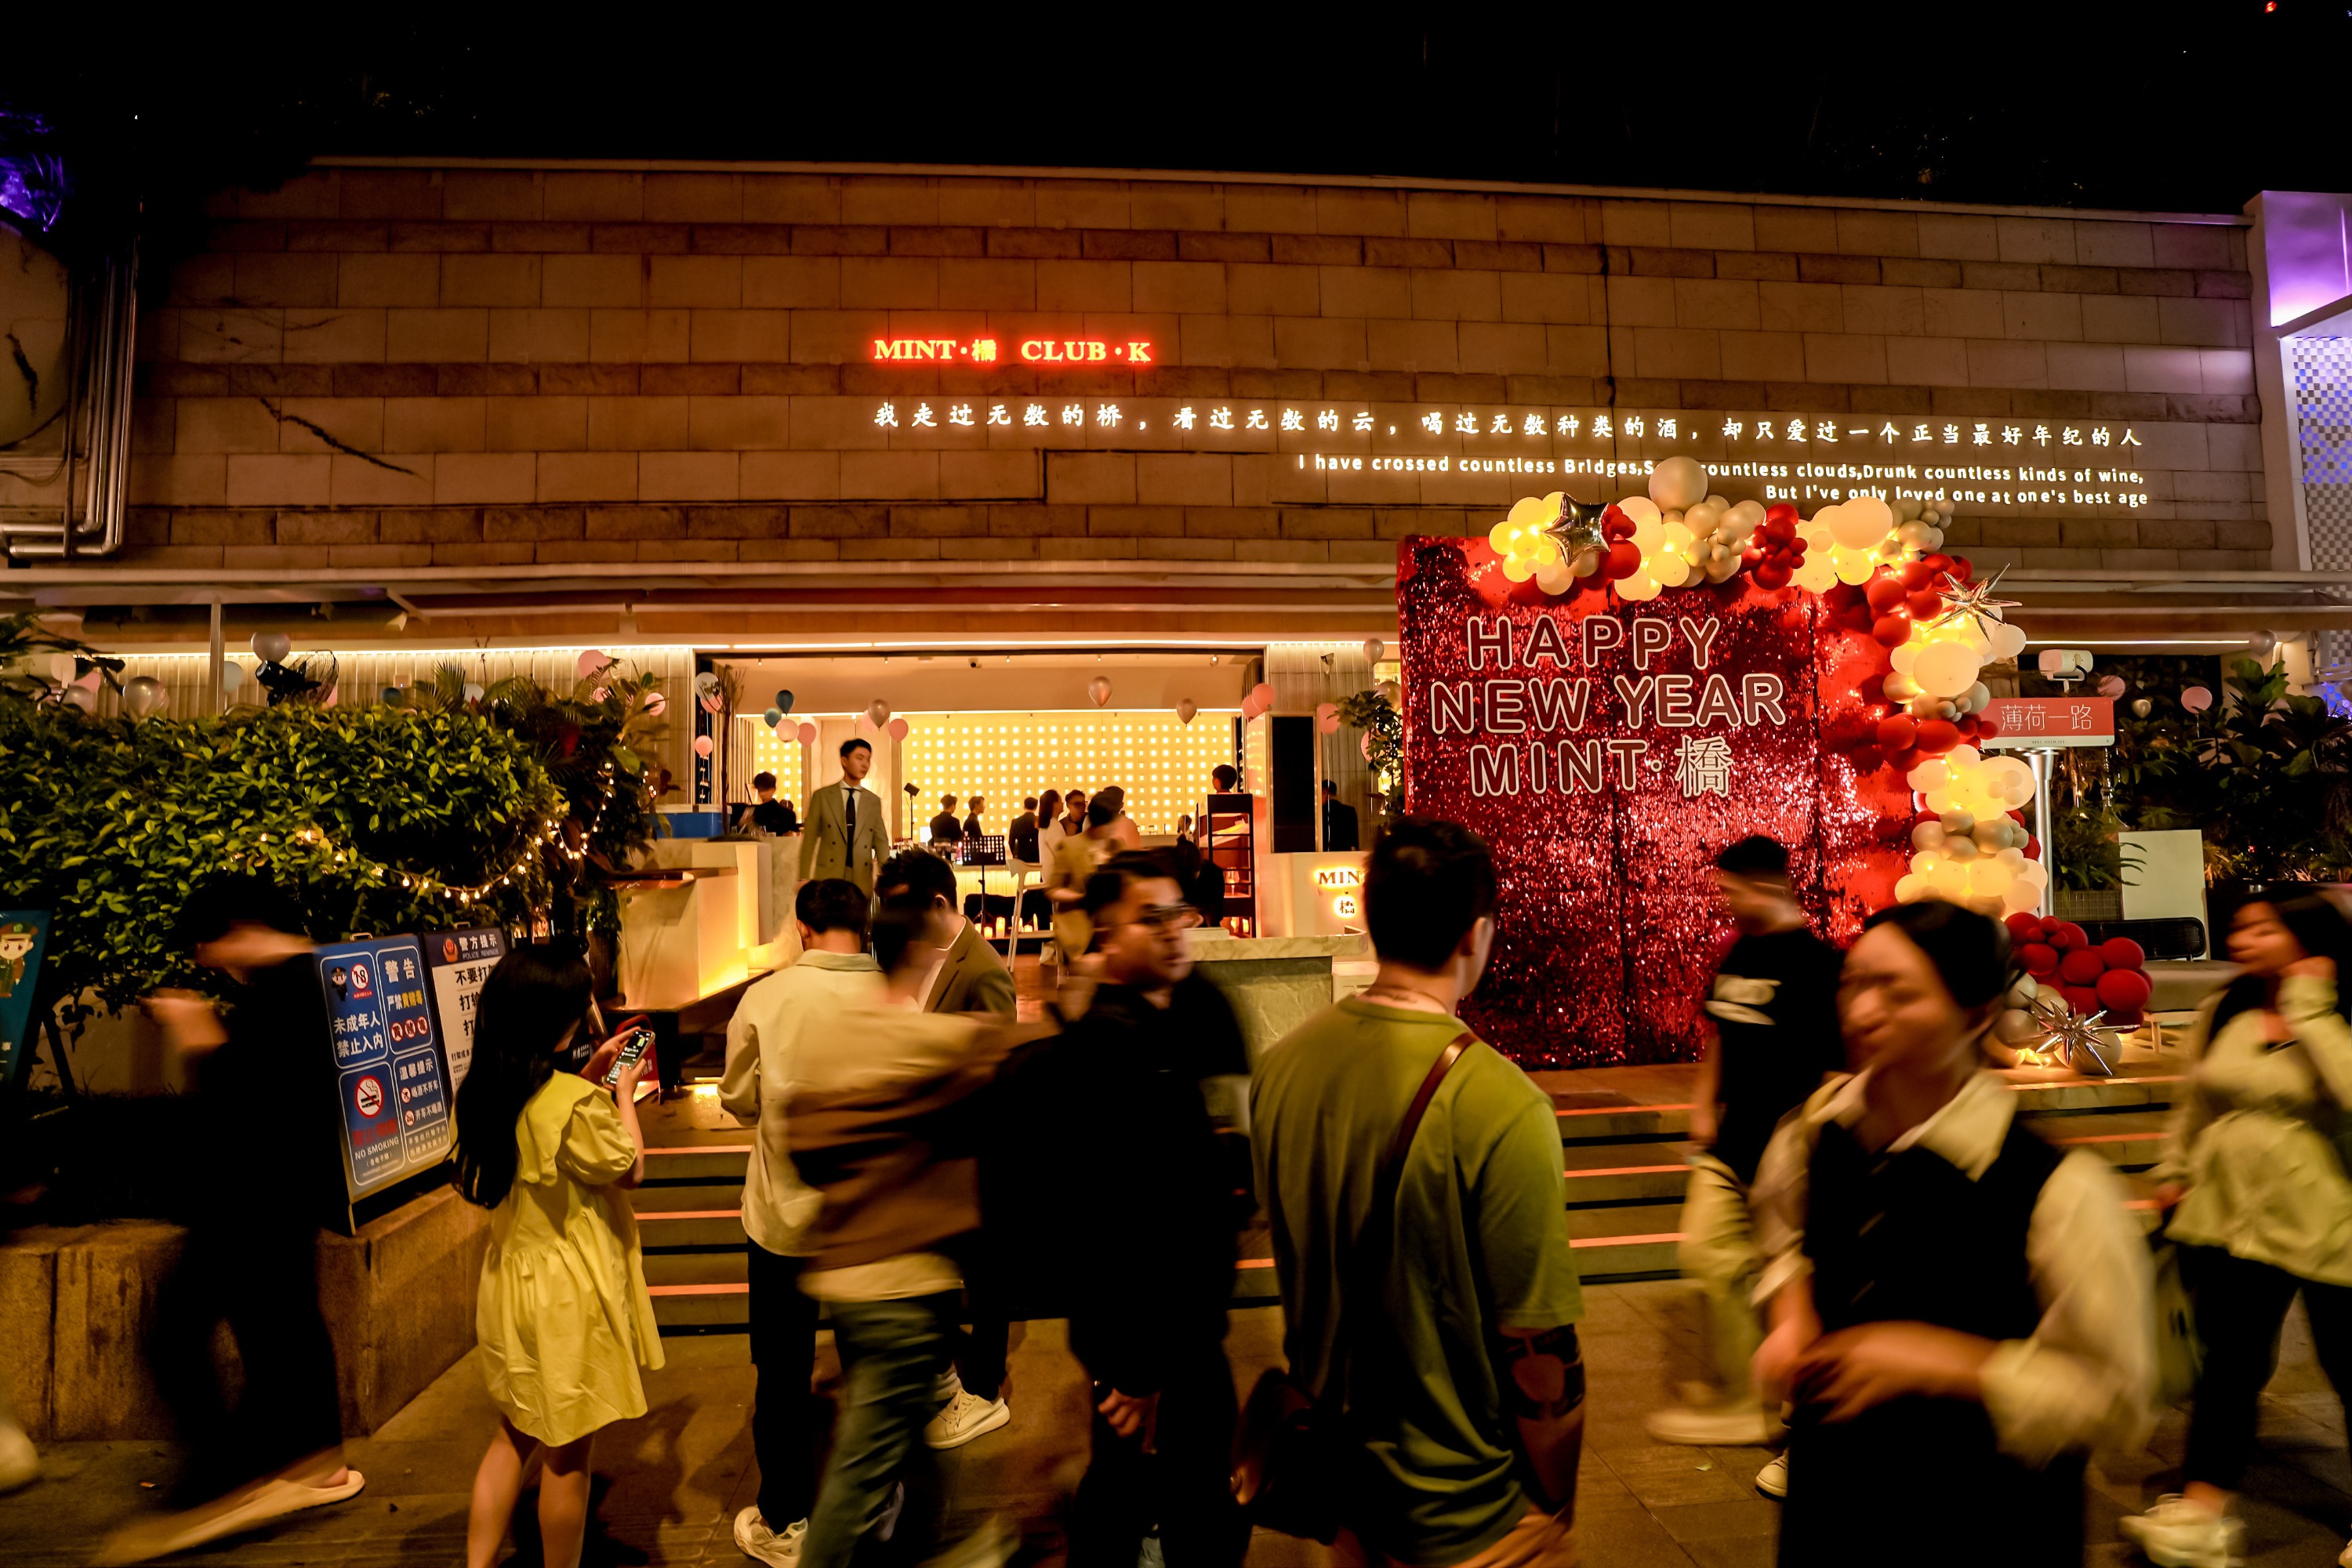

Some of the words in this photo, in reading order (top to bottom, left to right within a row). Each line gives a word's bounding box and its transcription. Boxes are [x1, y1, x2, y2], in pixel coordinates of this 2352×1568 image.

[1299, 454, 1304, 470] I
[1316, 453, 1362, 470] have
[1372, 456, 1449, 472] crossed
[1459, 457, 1555, 474] countless
[1564, 459, 1654, 478] Bridges,S
[1924, 466, 2011, 481] countless
[2019, 466, 2066, 482] kinds
[2074, 468, 2090, 483] of
[2098, 468, 2143, 485] wine,
[1766, 485, 1798, 500] But
[1806, 485, 1839, 501] I've
[1848, 485, 1886, 503] only
[1896, 485, 1944, 502] loved
[1952, 490, 1985, 503] one
[1991, 491, 2011, 505] at
[2017, 488, 2066, 504] one's
[2073, 489, 2111, 505] best
[2118, 492, 2147, 508] age
[1467, 613, 1719, 670] HAPPY
[1431, 677, 1590, 735] NEW
[1614, 673, 1786, 729] YEAR
[1999, 703, 2093, 732] 薄荷一路
[1317, 870, 1366, 885] MIN
[459, 934, 497, 952] 警方提示
[384, 957, 416, 983] 警告
[333, 1010, 381, 1035] 未成年人
[337, 1032, 383, 1058] 禁止入内
[354, 1150, 367, 1161] NO
[367, 1136, 400, 1156] SMOKING
